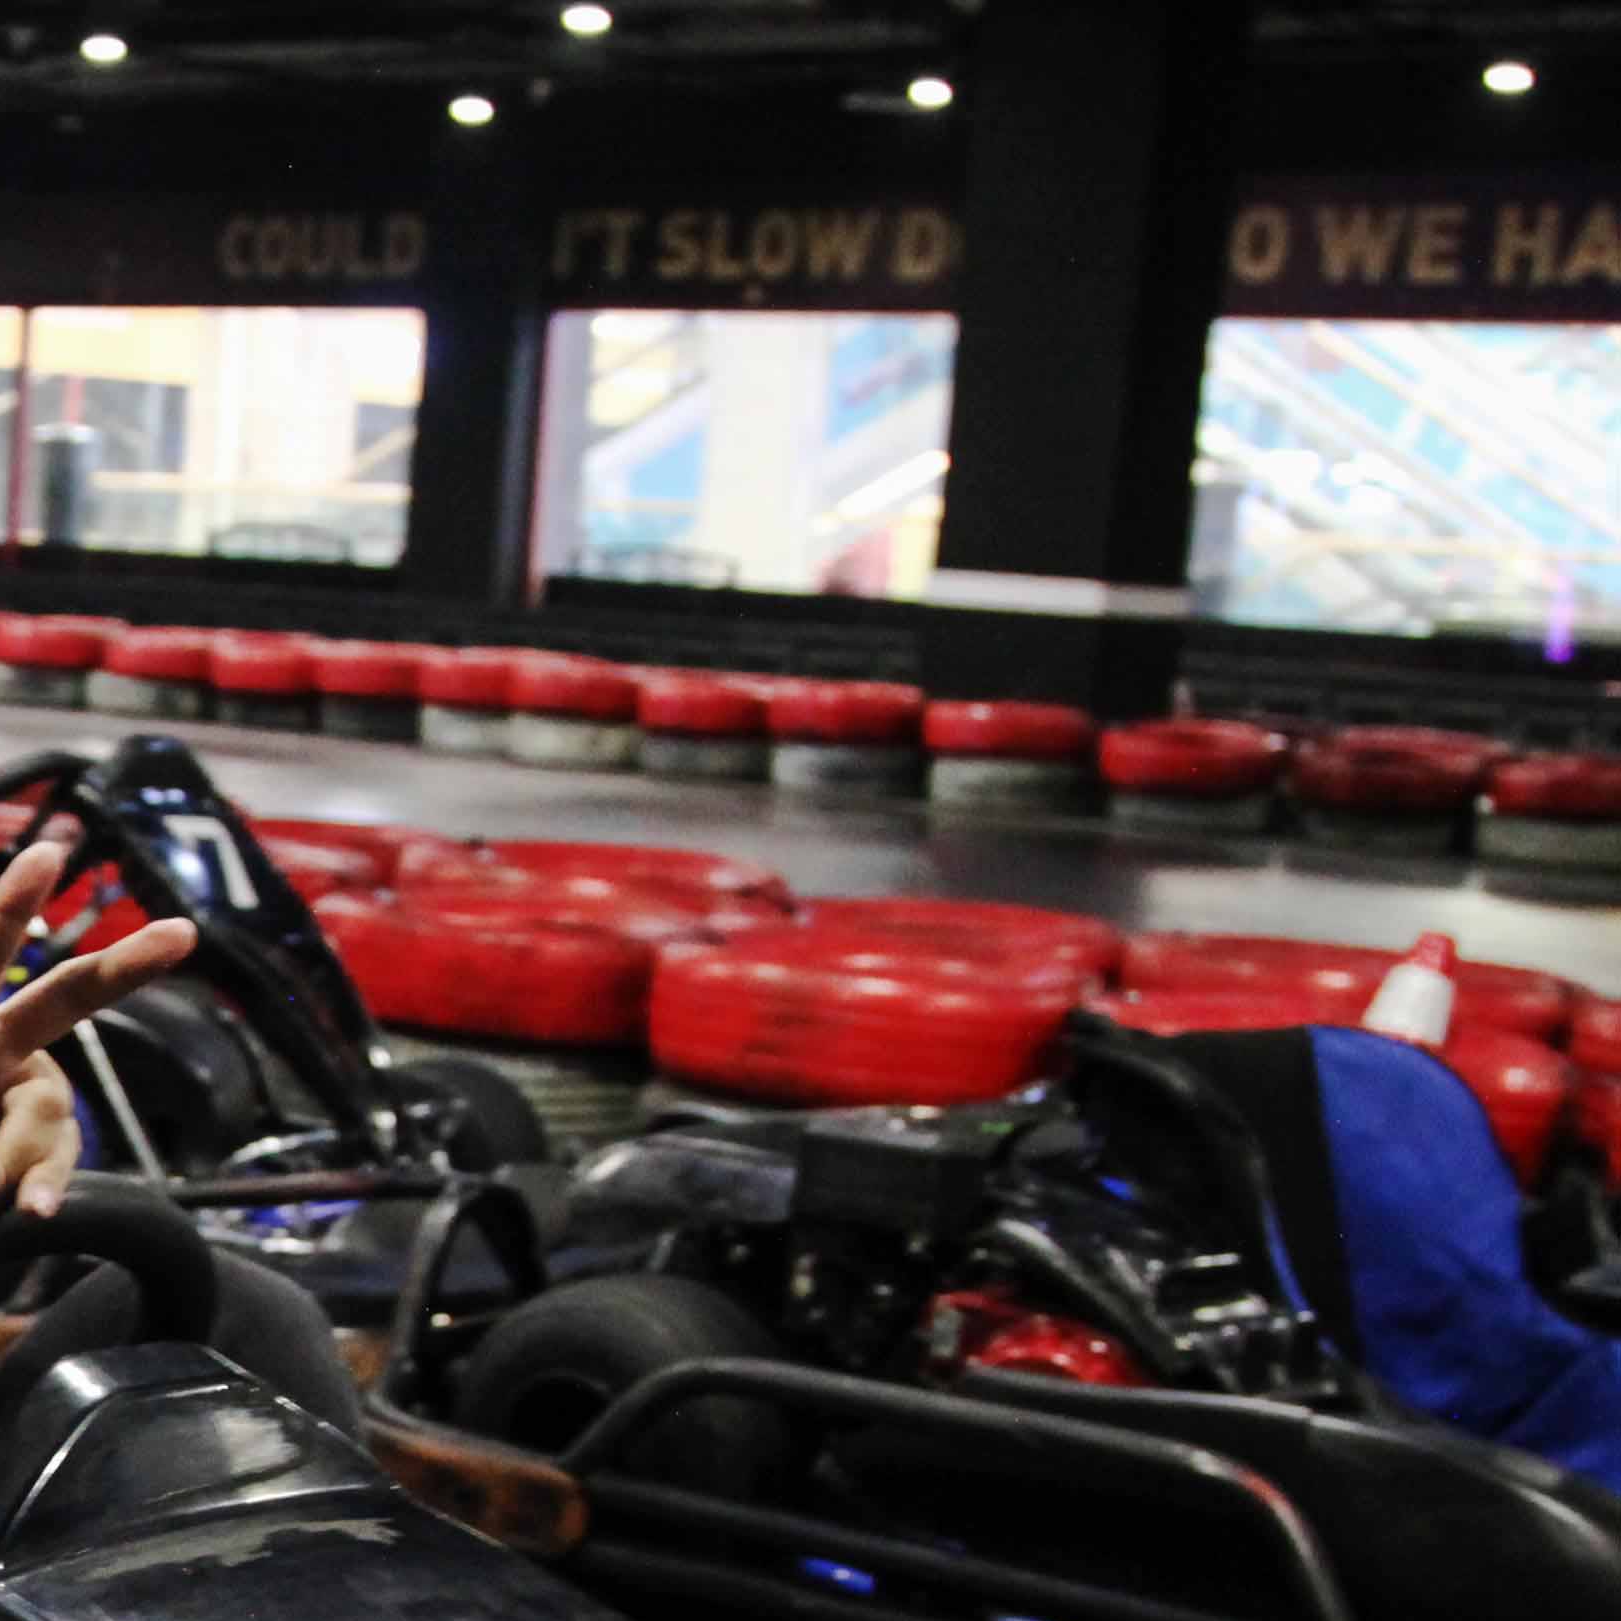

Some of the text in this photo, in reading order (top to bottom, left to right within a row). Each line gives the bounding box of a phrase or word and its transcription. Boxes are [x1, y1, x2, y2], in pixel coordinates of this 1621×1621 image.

[219, 212, 424, 276] COULD
[656, 208, 881, 281] SLOW
[1315, 205, 1465, 284] WE
[162, 814, 258, 909] 7
